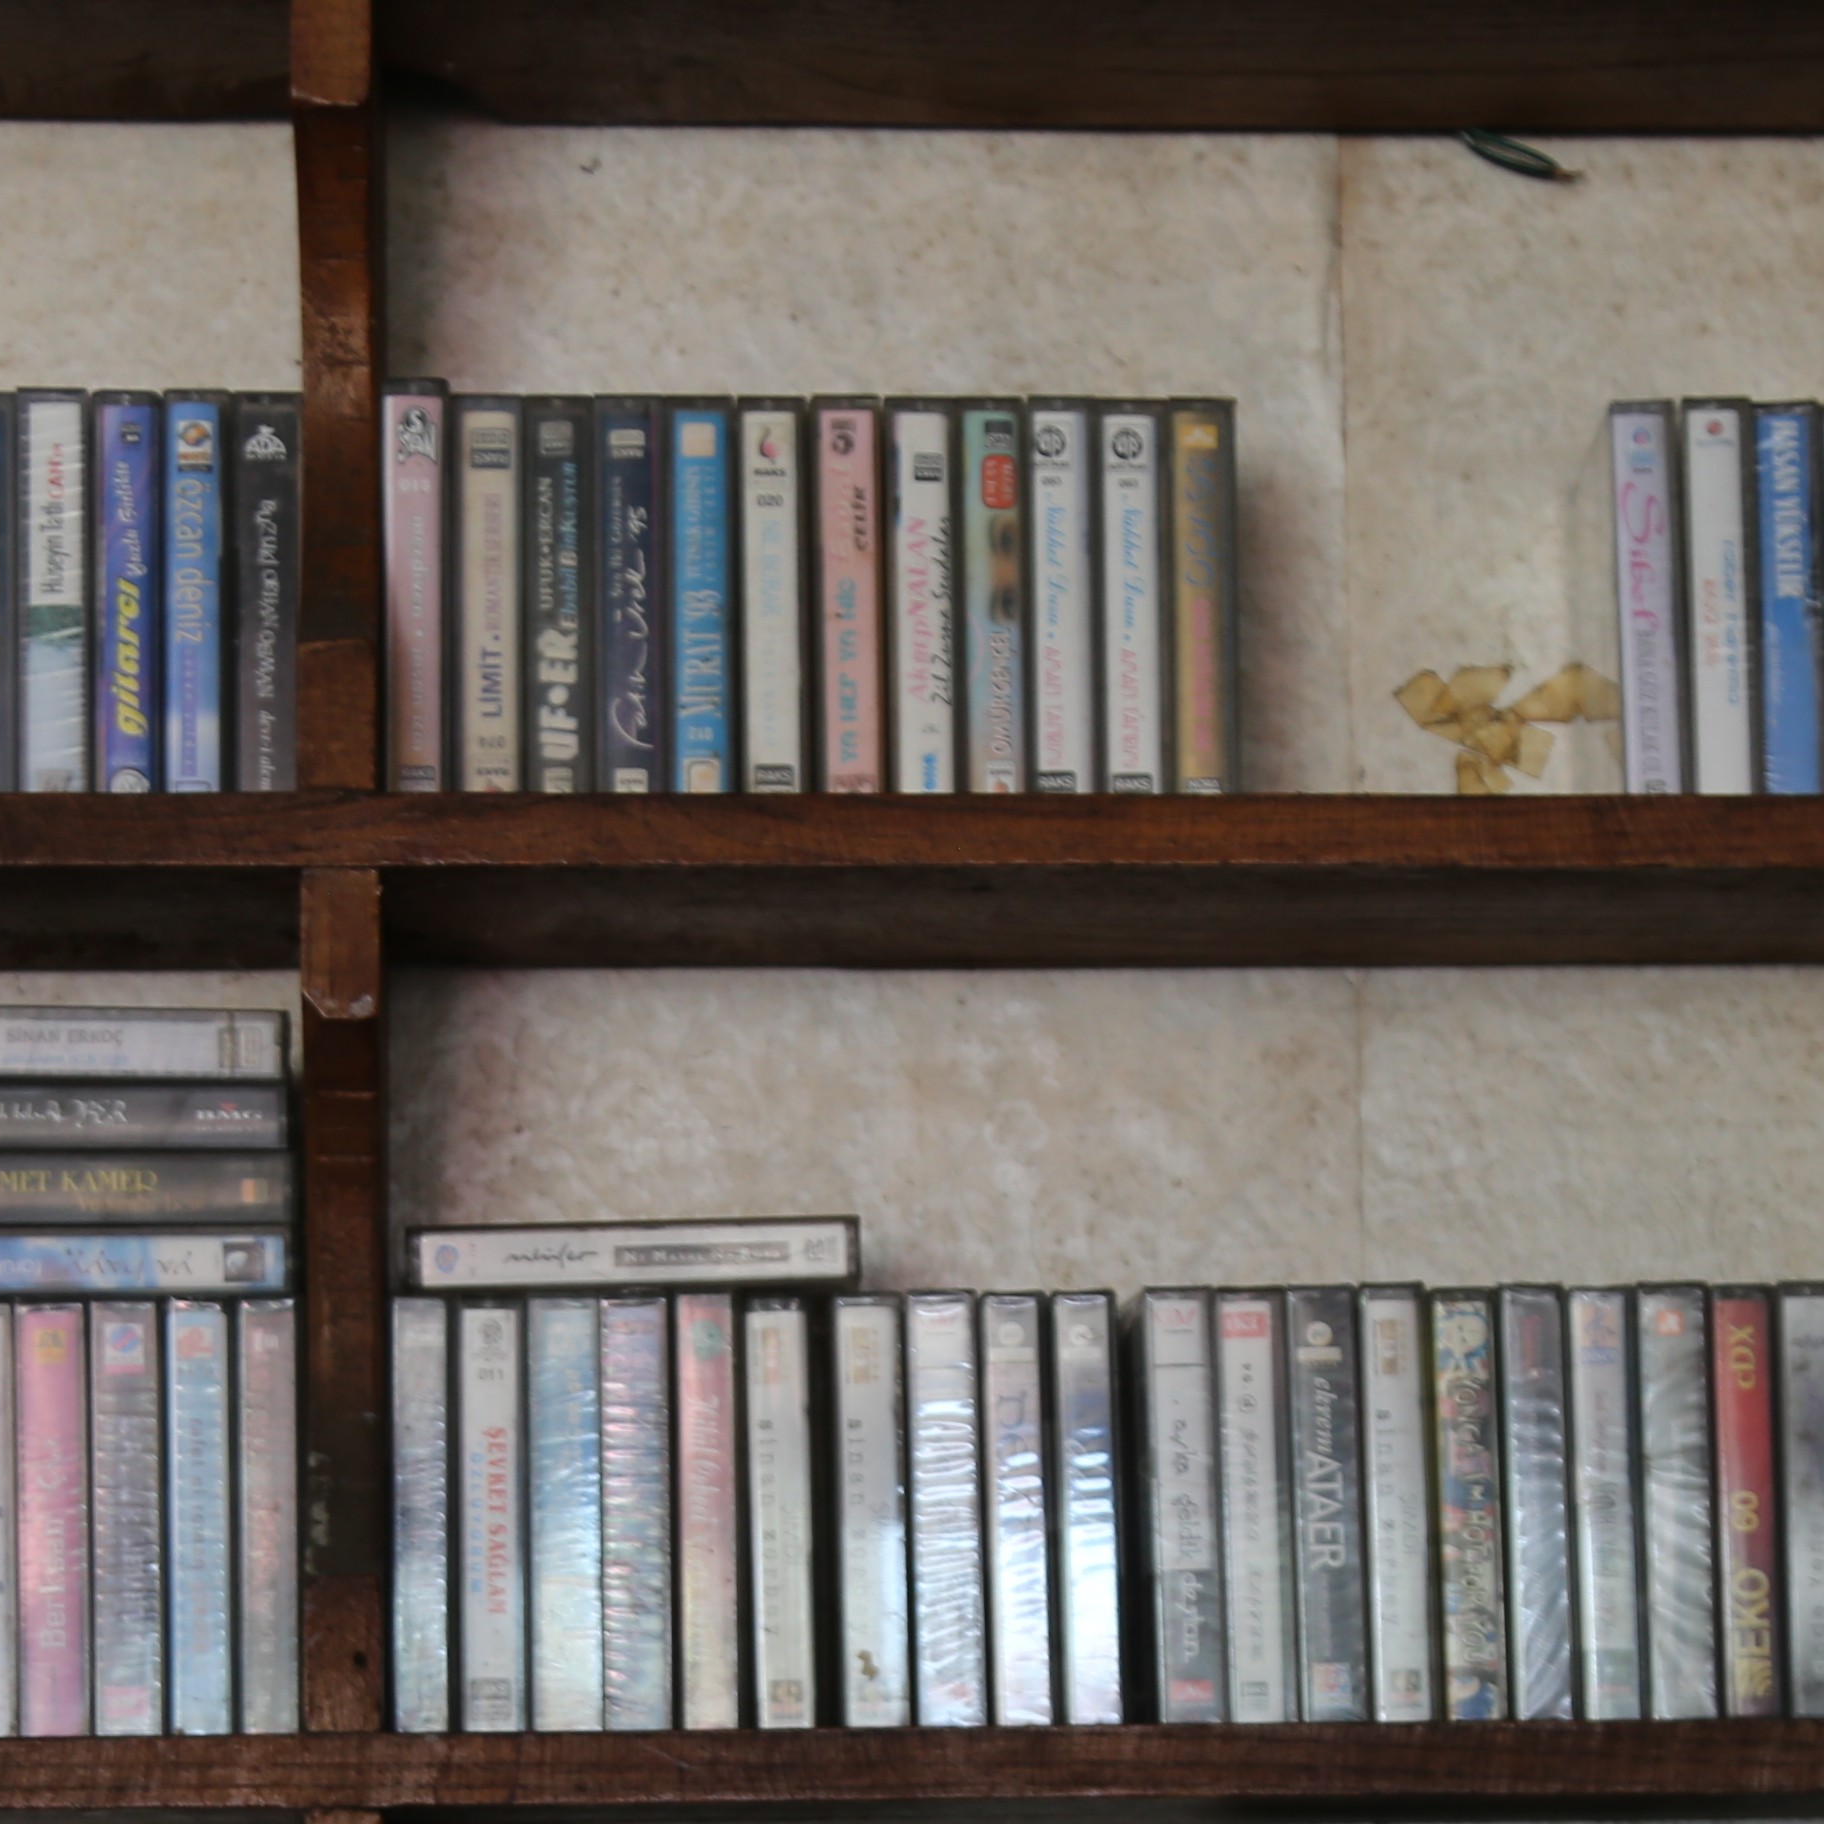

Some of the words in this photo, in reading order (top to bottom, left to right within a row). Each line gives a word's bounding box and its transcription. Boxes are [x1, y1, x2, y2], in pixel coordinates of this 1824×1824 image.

[177, 478, 213, 558] özcan
[177, 568, 214, 643] deniz
[113, 578, 148, 738] gitarcı
[478, 648, 503, 718] LİMİT
[679, 630, 722, 718] MURAT
[1313, 1377, 1334, 1453] ekrem
[482, 1427, 506, 1515] ŞEVKET
[1307, 1450, 1345, 1569] ATAER
[1732, 1490, 1760, 1532] 60
[486, 1524, 512, 1614] SAĞLAM
[1463, 1509, 1489, 1557] HOT
[1732, 1566, 1770, 1657] EKO
